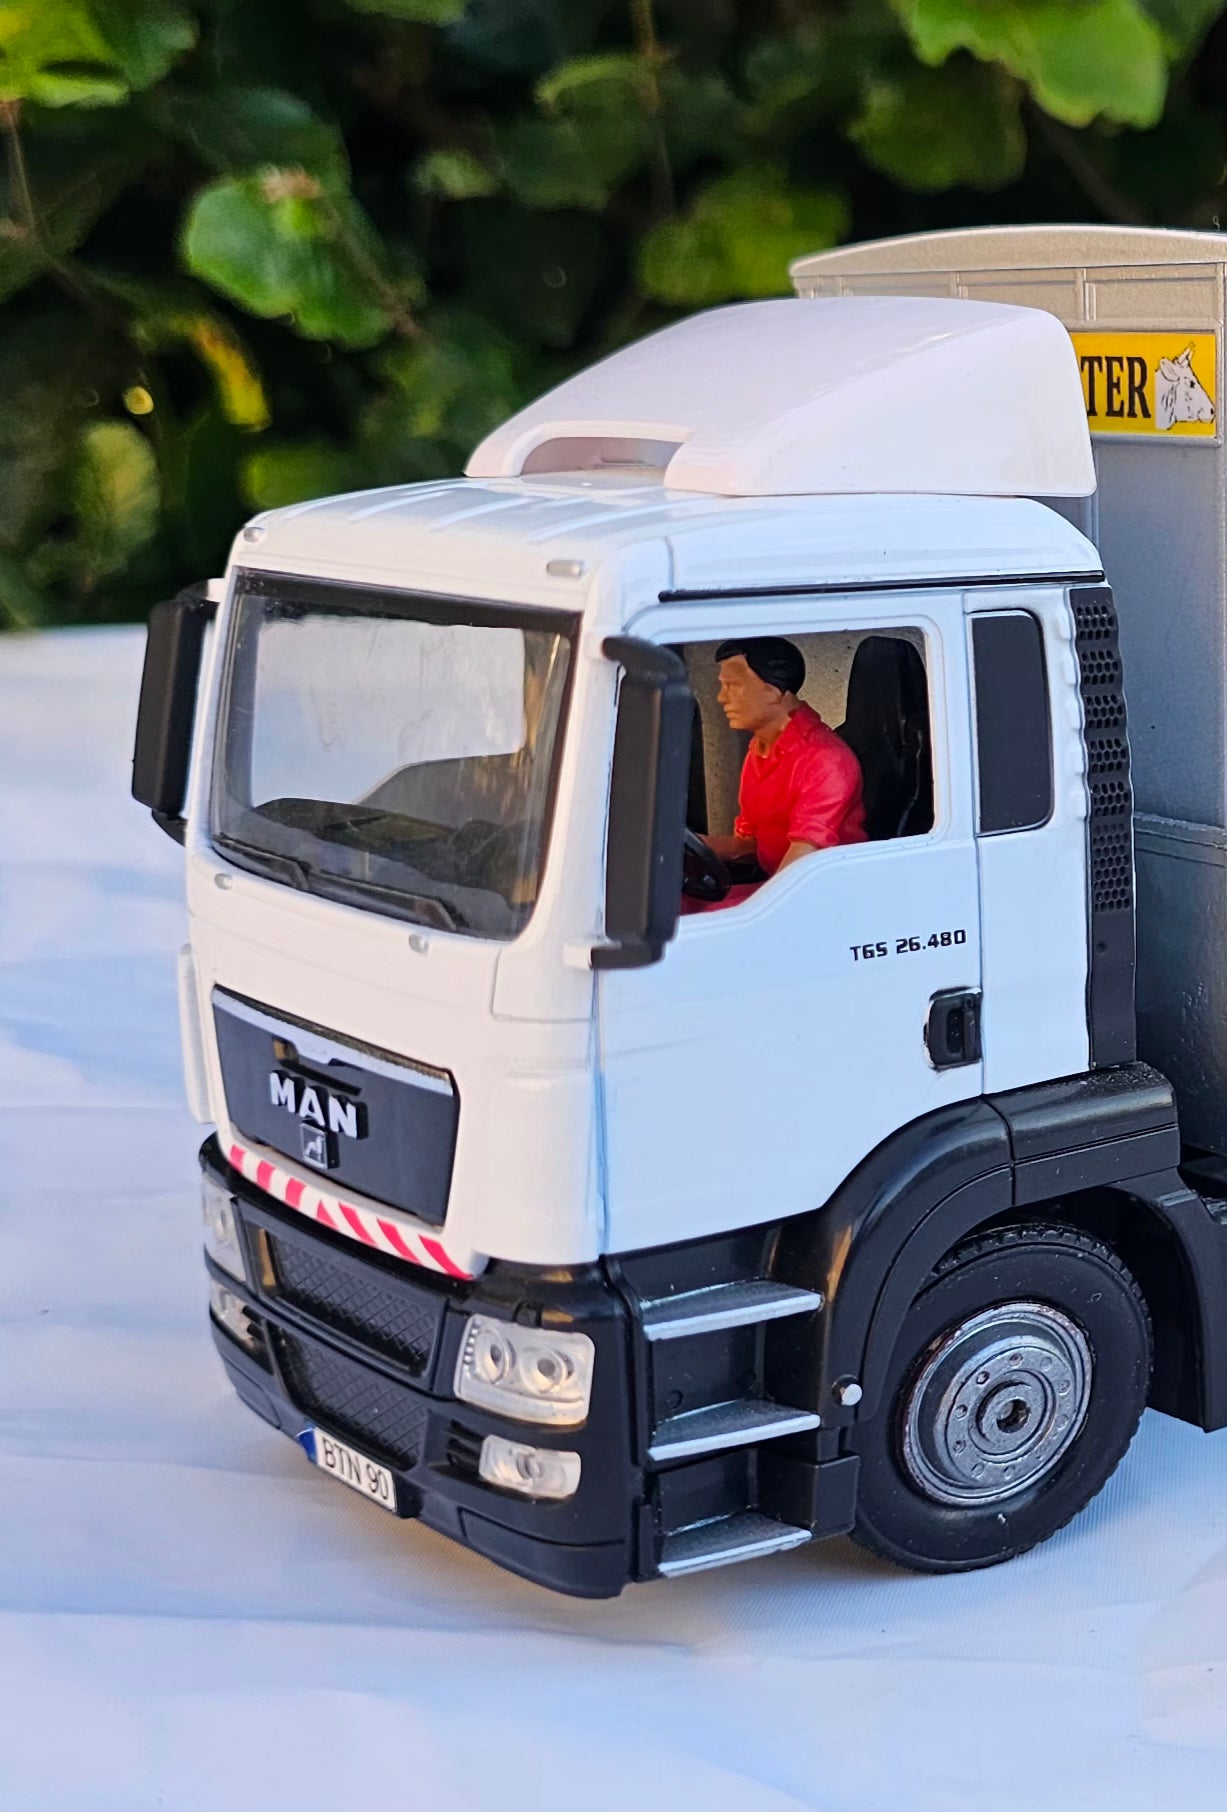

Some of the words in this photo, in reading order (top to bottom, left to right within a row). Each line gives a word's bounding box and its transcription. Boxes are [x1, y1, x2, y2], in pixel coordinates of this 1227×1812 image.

[1080, 356, 1152, 418] TER
[896, 929, 967, 954] 26.480
[269, 1071, 358, 1139] MAN
[366, 1463, 389, 1500] 90
